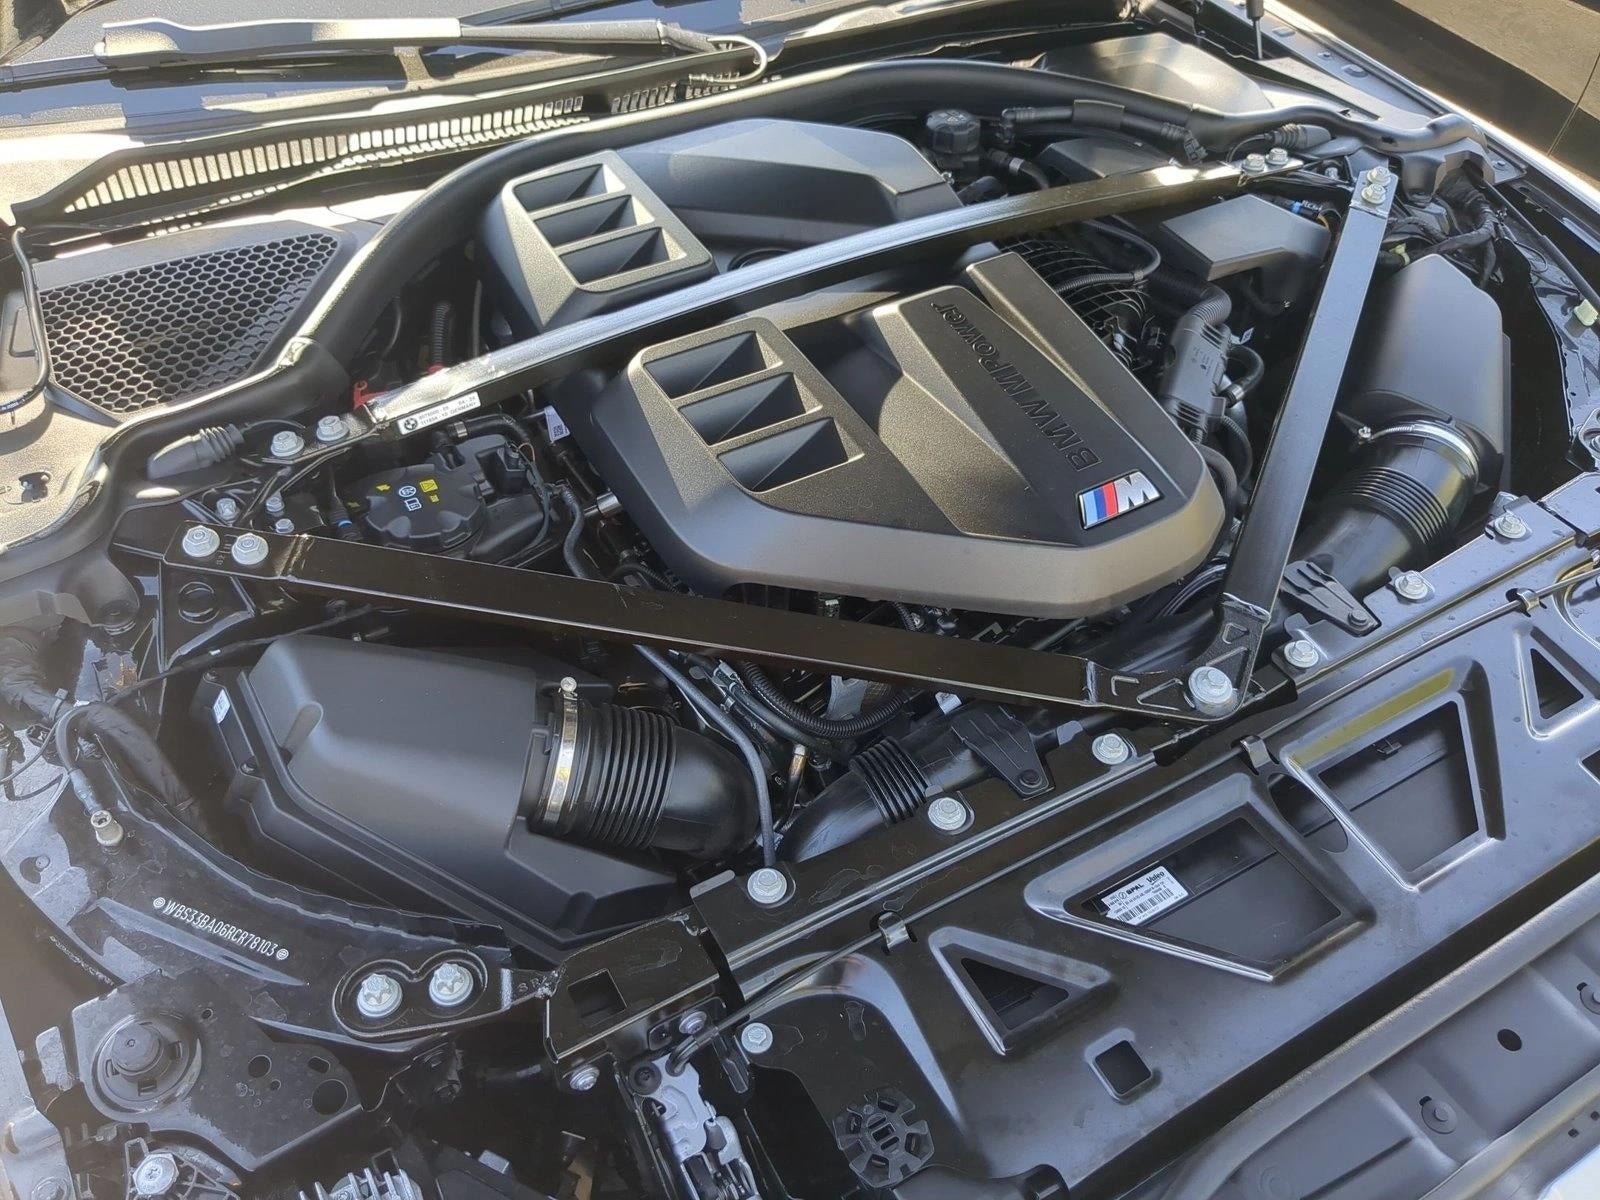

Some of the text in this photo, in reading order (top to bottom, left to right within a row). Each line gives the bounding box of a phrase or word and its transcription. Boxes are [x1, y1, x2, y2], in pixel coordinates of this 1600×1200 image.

[1016, 400, 1102, 472] BMW
[1113, 471, 1160, 513] M
[1146, 871, 1165, 884] Valeo
[162, 899, 279, 957] WBS33BA06RCR78103
